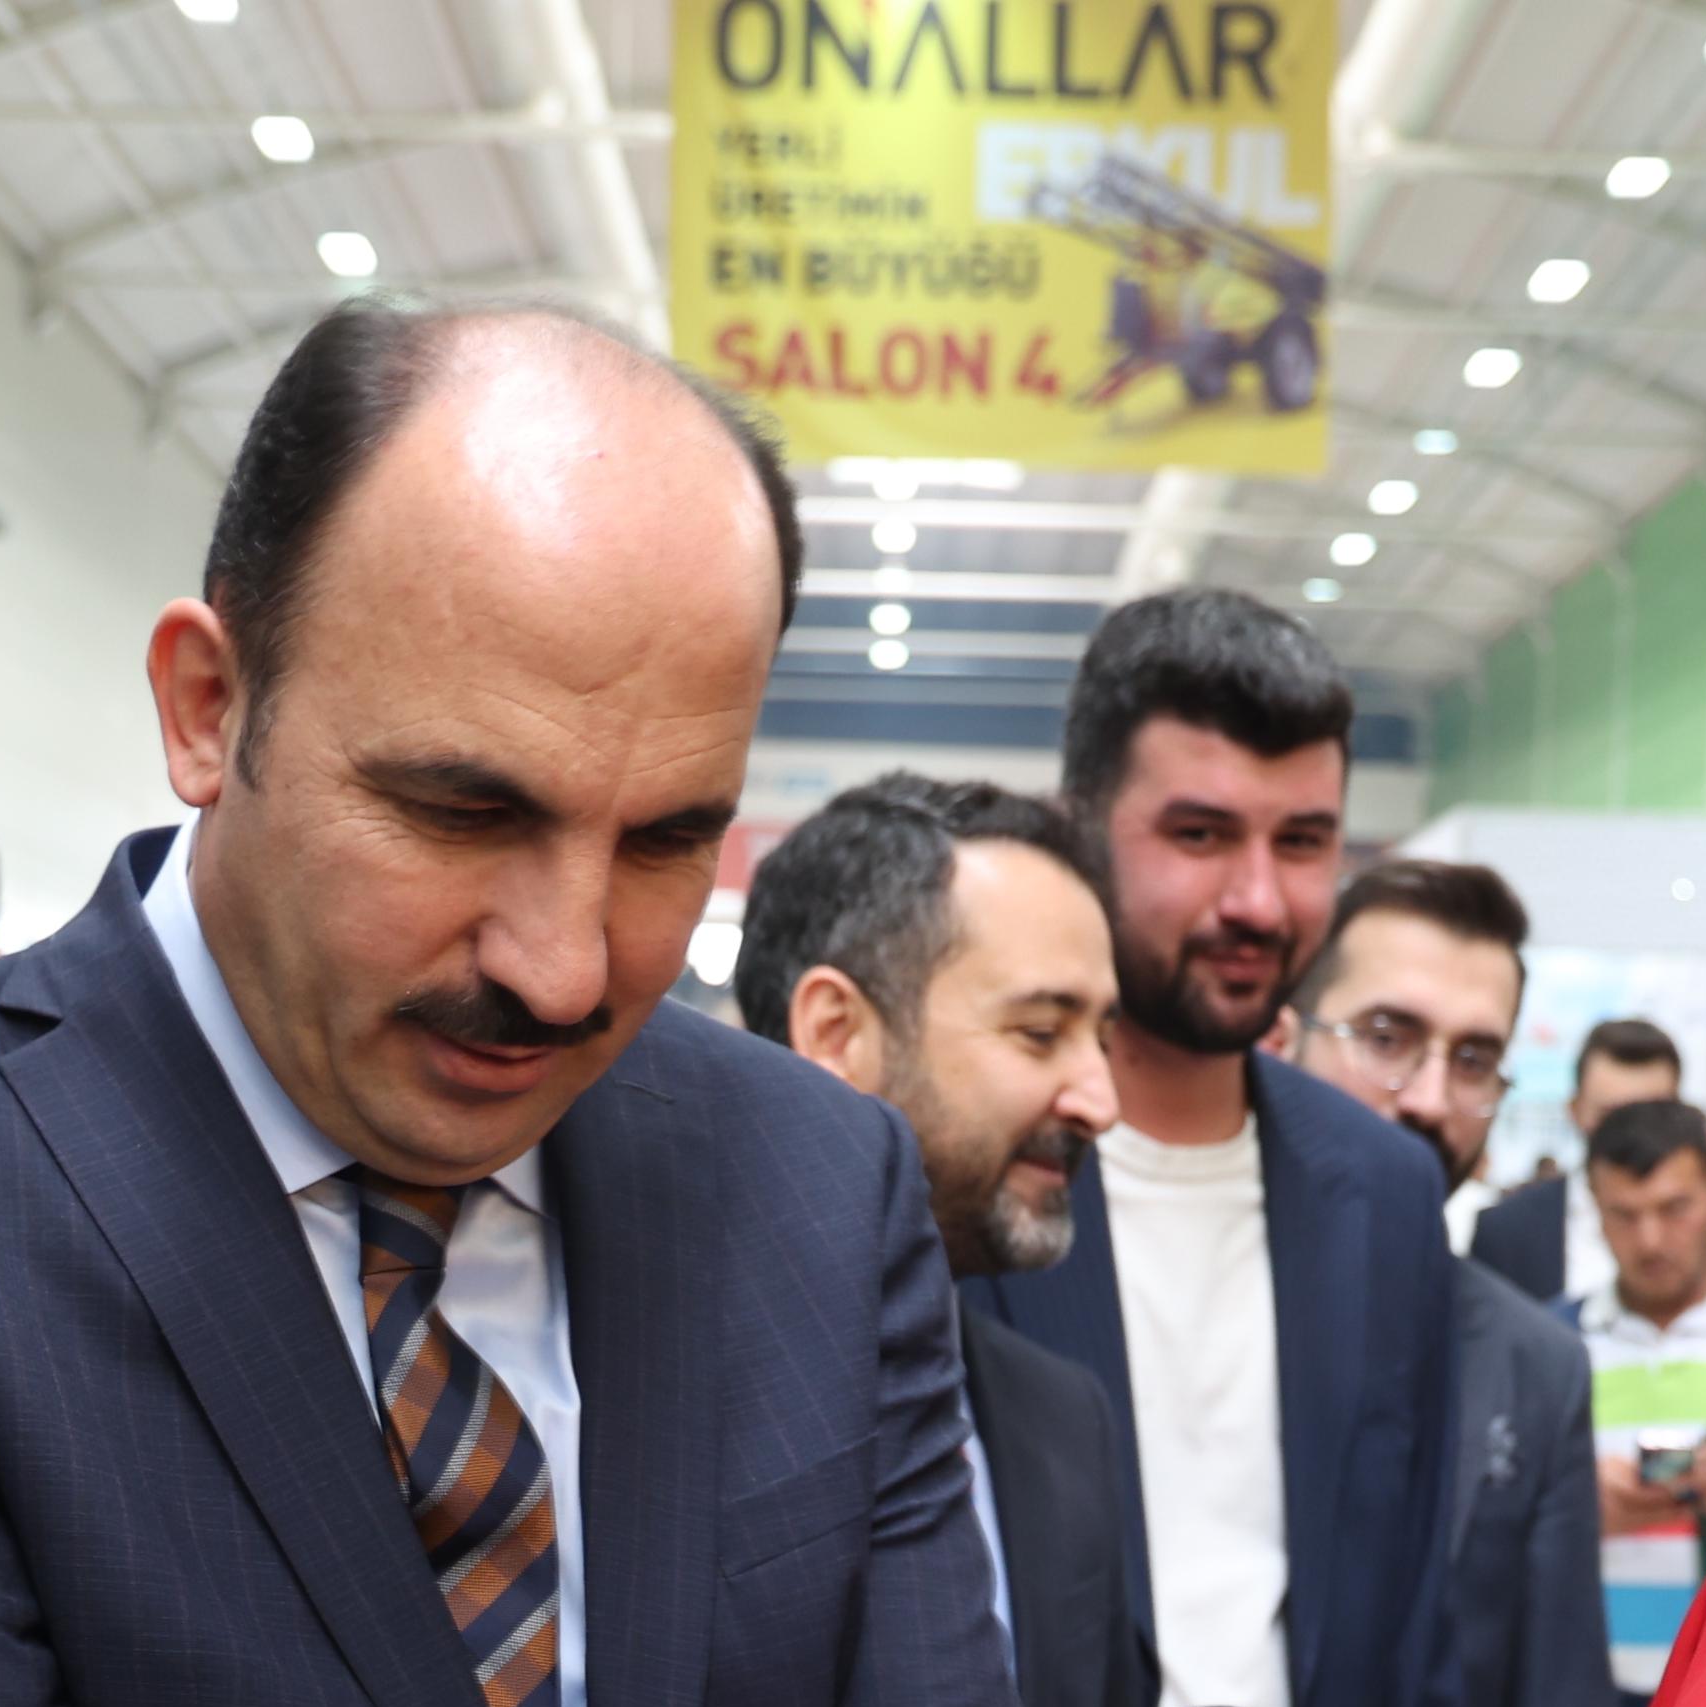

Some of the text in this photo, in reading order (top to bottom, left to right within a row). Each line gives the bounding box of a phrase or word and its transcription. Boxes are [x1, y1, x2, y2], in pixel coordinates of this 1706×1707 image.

[710, 242, 786, 294] EN
[713, 326, 1061, 399] SALON 4
